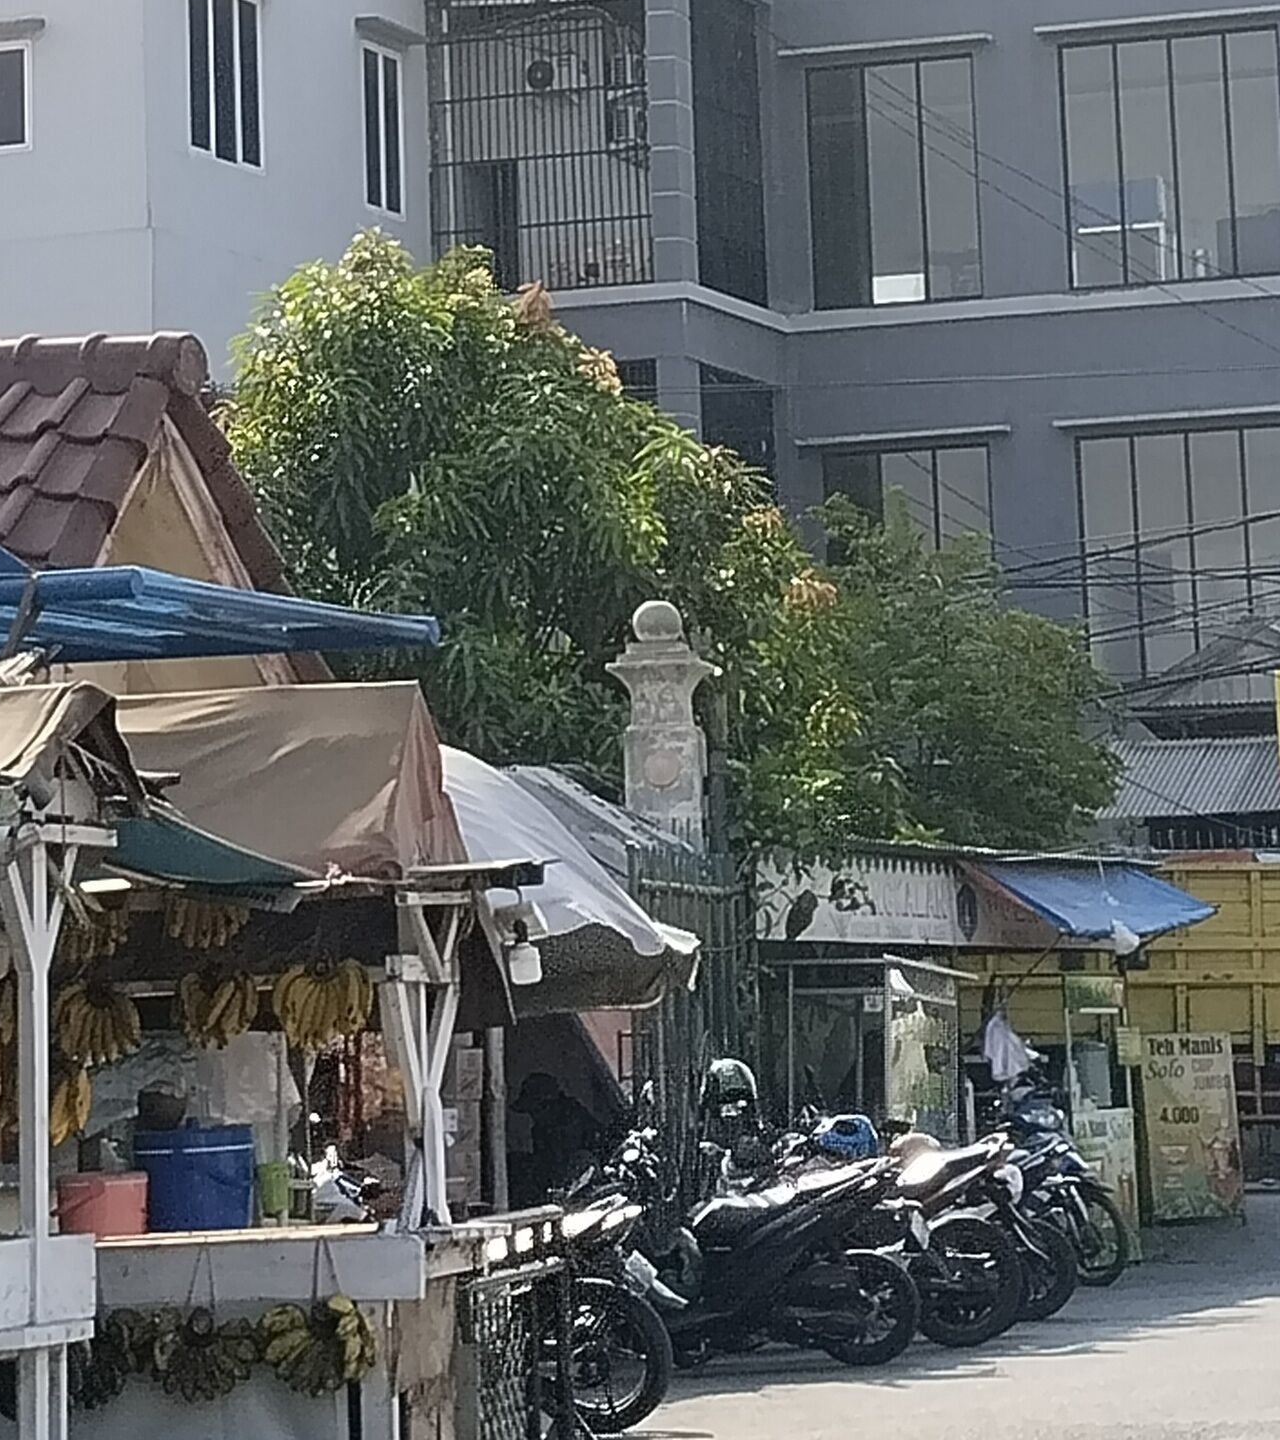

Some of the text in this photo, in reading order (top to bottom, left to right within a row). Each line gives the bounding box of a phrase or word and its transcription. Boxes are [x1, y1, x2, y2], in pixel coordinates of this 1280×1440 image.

[1147, 1036, 1224, 1057] Teh Manis
[1159, 1105, 1200, 1125] 4.000
